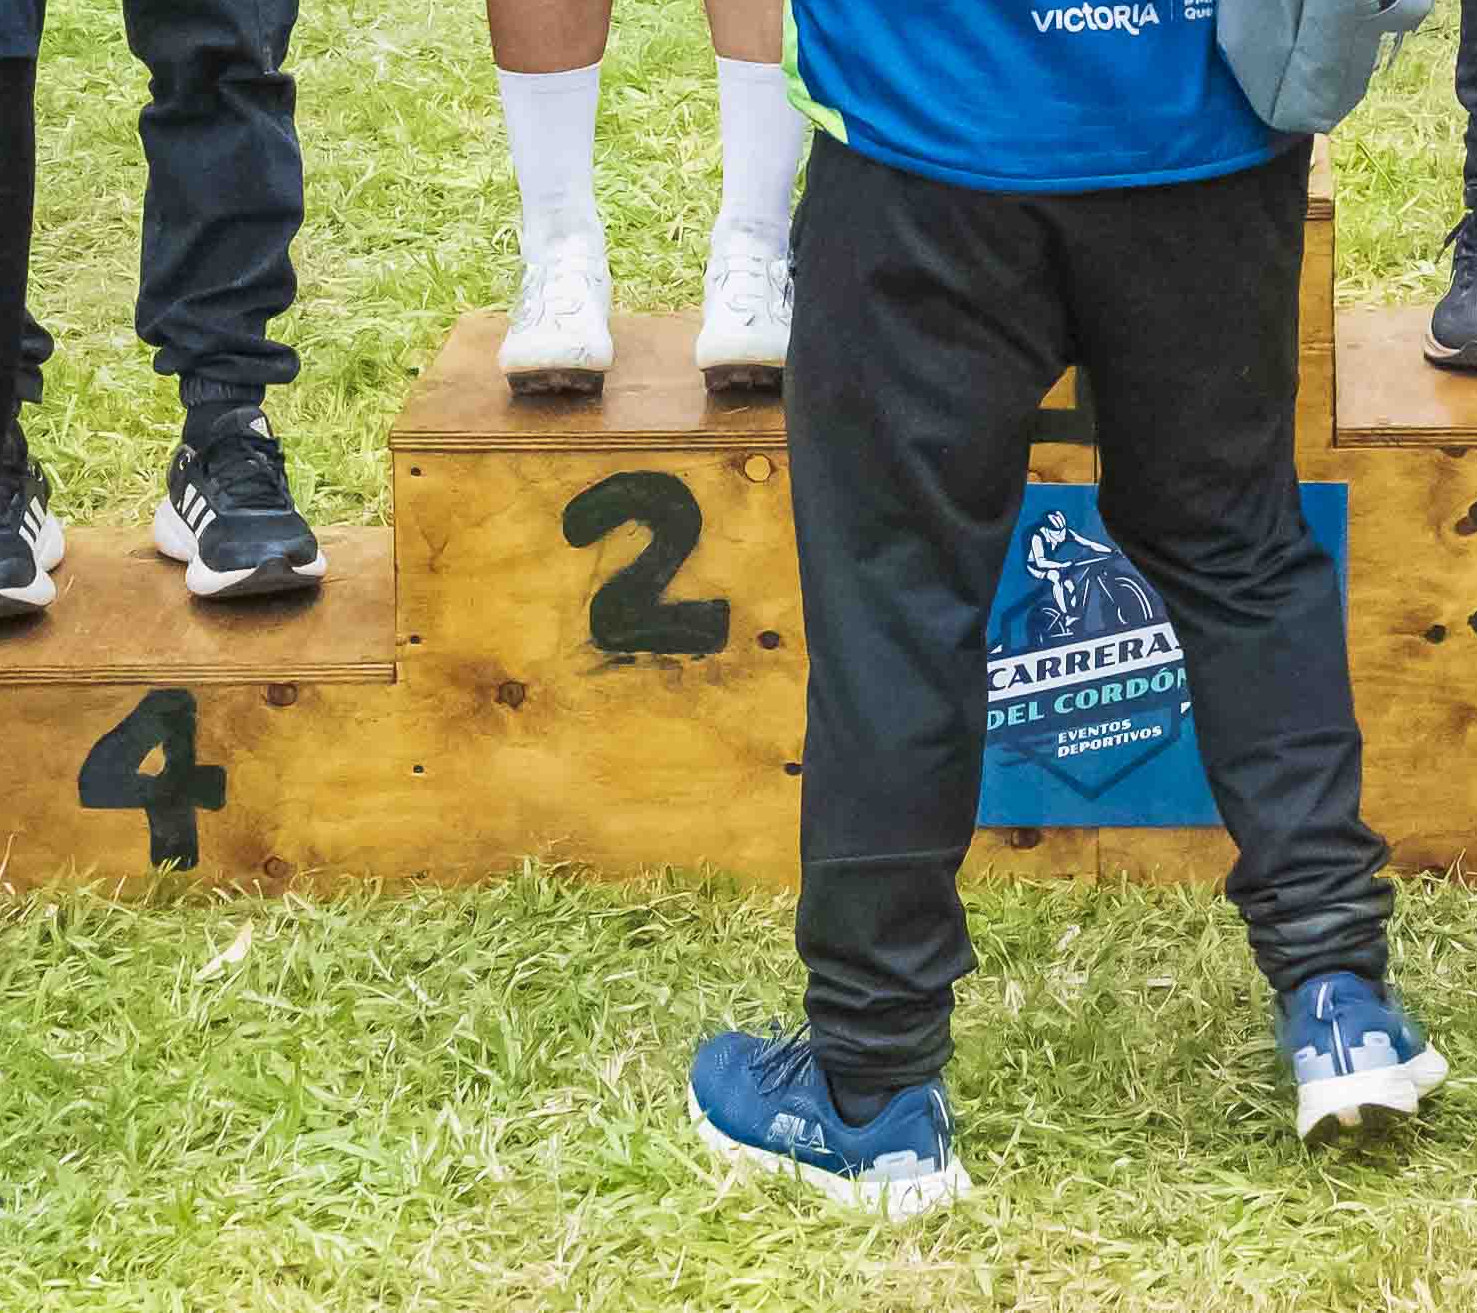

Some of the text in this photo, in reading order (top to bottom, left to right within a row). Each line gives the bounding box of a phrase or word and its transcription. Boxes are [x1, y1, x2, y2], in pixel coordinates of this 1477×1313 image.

[561, 470, 729, 655] 2
[987, 631, 1181, 691] CARRERA
[987, 700, 1044, 730] DEL
[1058, 719, 1131, 744] EVENTOS
[1058, 726, 1162, 758] DEPORTIVOS
[78, 688, 227, 871] 4
